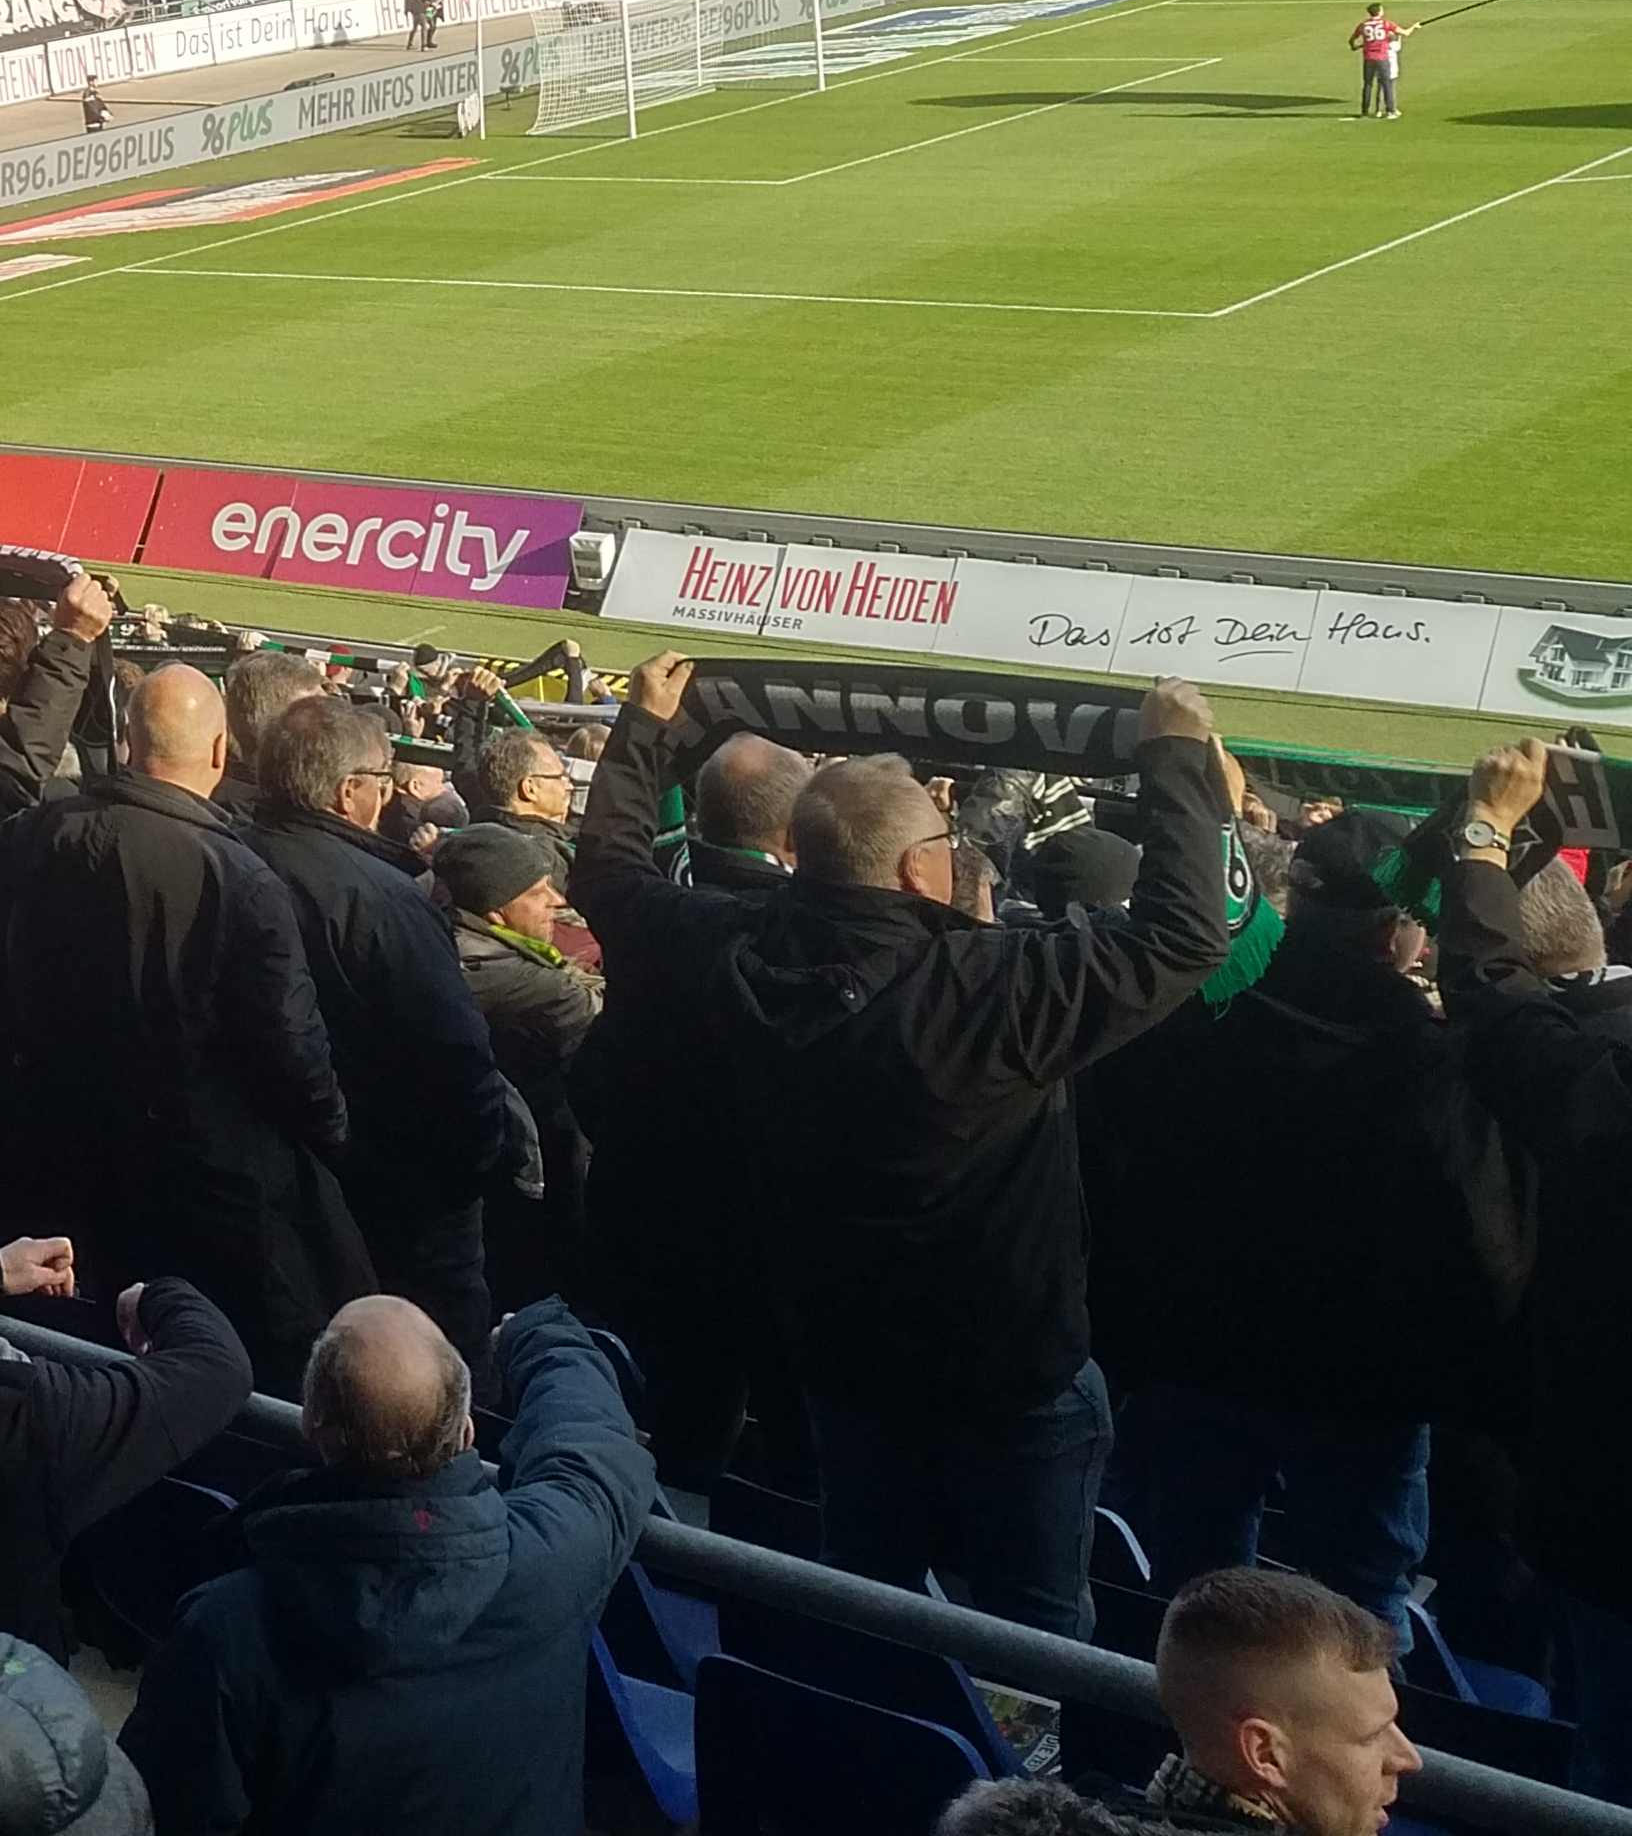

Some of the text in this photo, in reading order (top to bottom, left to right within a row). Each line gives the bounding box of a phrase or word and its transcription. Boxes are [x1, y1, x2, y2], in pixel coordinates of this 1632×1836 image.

[175, 29, 210, 58] Das
[219, 24, 242, 52] ist
[251, 13, 295, 47] Dein
[304, 5, 360, 37] Haus.
[1364, 25, 1386, 41] 96
[53, 45, 90, 95] VON
[88, 30, 157, 83] HEIDEN
[299, 60, 480, 130] MEHR INFOS UNTER
[211, 500, 532, 592] enercity
[679, 546, 959, 625] HEINZ VON HEIDEN
[672, 604, 805, 632] MASSIVHÄUSER
[1028, 609, 1432, 649] Das ist Dein Haus.
